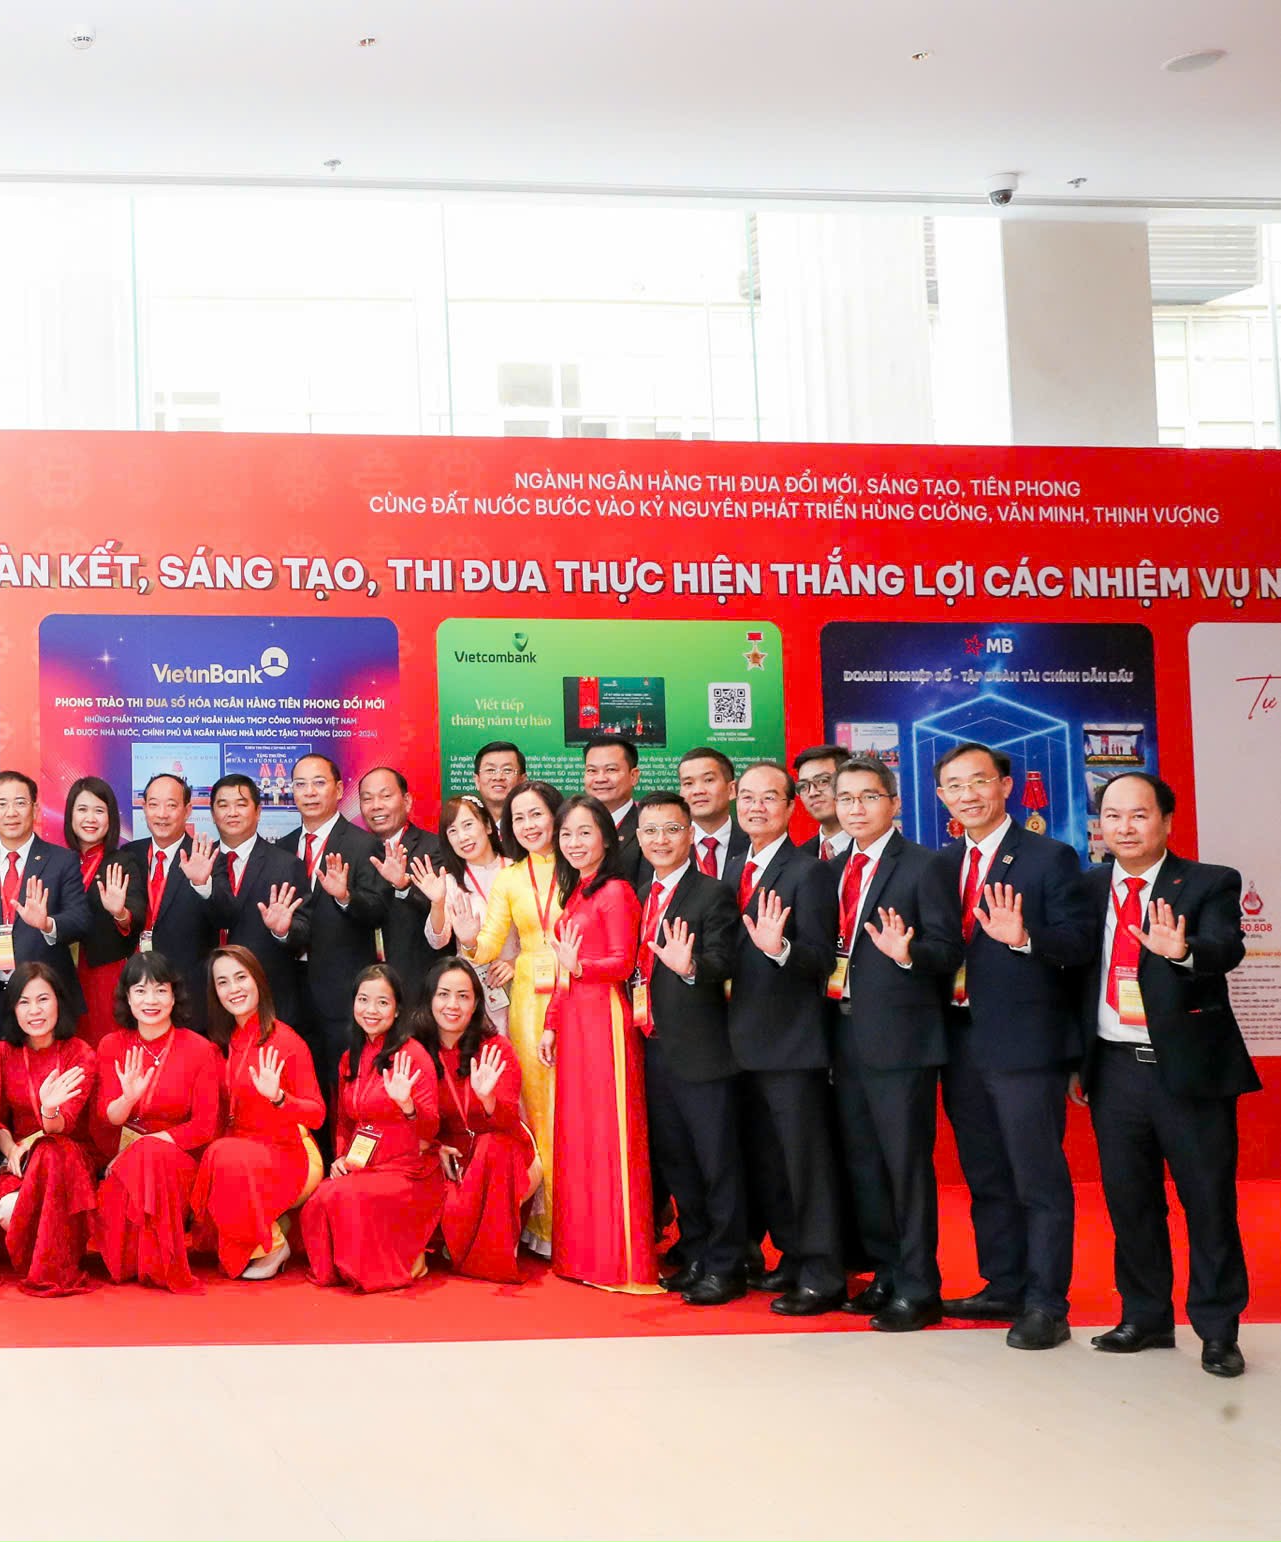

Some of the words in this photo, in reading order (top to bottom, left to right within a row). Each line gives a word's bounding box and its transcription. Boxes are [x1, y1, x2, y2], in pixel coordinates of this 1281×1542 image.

[515, 468, 584, 490] NGÀNH
[588, 470, 642, 490] NGÂN
[648, 470, 702, 491] HÀNG
[706, 476, 736, 492] THI
[740, 476, 780, 492] ĐUA
[785, 469, 818, 493] ĐỔI
[822, 473, 862, 496] MỚI,
[867, 473, 918, 495] SÁNG
[923, 479, 966, 500] TẠO,
[970, 475, 1011, 496] TIÊN
[1016, 480, 1080, 497] PHONG
[370, 491, 426, 513] CÙNG
[431, 490, 469, 514] ĐẤT
[474, 493, 531, 515] NƯỚC
[535, 494, 591, 516] BƯỚC
[596, 495, 634, 516] VÀO
[640, 495, 664, 517] KỶ
[669, 498, 747, 518] NGUYÊN
[752, 497, 800, 518] PHÁT
[806, 496, 856, 520] TRIỂN
[862, 501, 914, 520] HÙNG
[919, 500, 993, 522] CƯỜNG,
[997, 501, 1034, 522] VĂN
[1040, 506, 1089, 524] MINH,
[1093, 507, 1148, 526] THỊNH
[1152, 506, 1220, 527] VƯỢNG
[59, 541, 151, 594] KẾT,
[159, 546, 274, 589] SÁNG
[282, 557, 378, 600] TẠO,
[387, 559, 455, 592] THI
[461, 560, 548, 592] ĐUA
[555, 557, 665, 603] THỰC
[673, 555, 761, 605] HIỆN
[770, 547, 905, 596] THẮNG
[913, 560, 975, 606] LỢI
[983, 557, 1064, 597] CÁC
[1072, 559, 1190, 608] NHIỆM
[1198, 567, 1251, 608] VỤ
[986, 638, 1013, 653] MB
[454, 651, 537, 664] Vietcombank
[152, 663, 264, 684] VietinBank
[843, 670, 887, 682] DOANH
[889, 669, 930, 685] NGHIỆP
[934, 668, 952, 682] SỐ
[960, 669, 983, 685] TẬP
[984, 669, 1020, 682] ĐOÀN
[1022, 668, 1040, 682] TÀI
[1042, 669, 1080, 682] CHÍNH
[1081, 667, 1107, 682] DẪN
[55, 697, 93, 708] PHONG
[95, 695, 124, 708] TRÀO
[127, 698, 143, 708] THI
[146, 698, 168, 708] ĐUA
[171, 694, 186, 708] SỐ
[188, 696, 211, 708] HÓA
[214, 697, 244, 708] NGÂN
[246, 696, 276, 709] HÀNG
[279, 697, 301, 709] TIÊN
[303, 699, 340, 709] PHONG
[343, 696, 362, 709] ĐỔI
[366, 697, 385, 709] MỚI
[475, 698, 499, 711] Viết
[501, 698, 524, 713] tiếp
[112, 714, 132, 723] PHẦN
[166, 716, 182, 724] CAO
[184, 714, 200, 724] QUÝ
[202, 715, 223, 724] NGÂN
[224, 714, 245, 724] HÀNG
[247, 716, 267, 724] TMCP
[268, 715, 291, 725] CÔNG
[292, 716, 323, 725] THƯƠNG
[324, 716, 339, 726] VIỆT
[340, 717, 357, 725] NAM
[451, 714, 485, 729] tháng
[515, 715, 528, 729] tự
[530, 714, 552, 726] hào
[100, 727, 116, 736] NHÀ
[142, 727, 165, 736] CHÍNH
[182, 727, 192, 736] VÀ
[194, 728, 215, 736] NGÂN
[216, 727, 237, 737] HÀNG
[239, 728, 254, 737] NHÀ
[256, 727, 277, 737] NƯỚC
[332, 729, 352, 738] (2020
